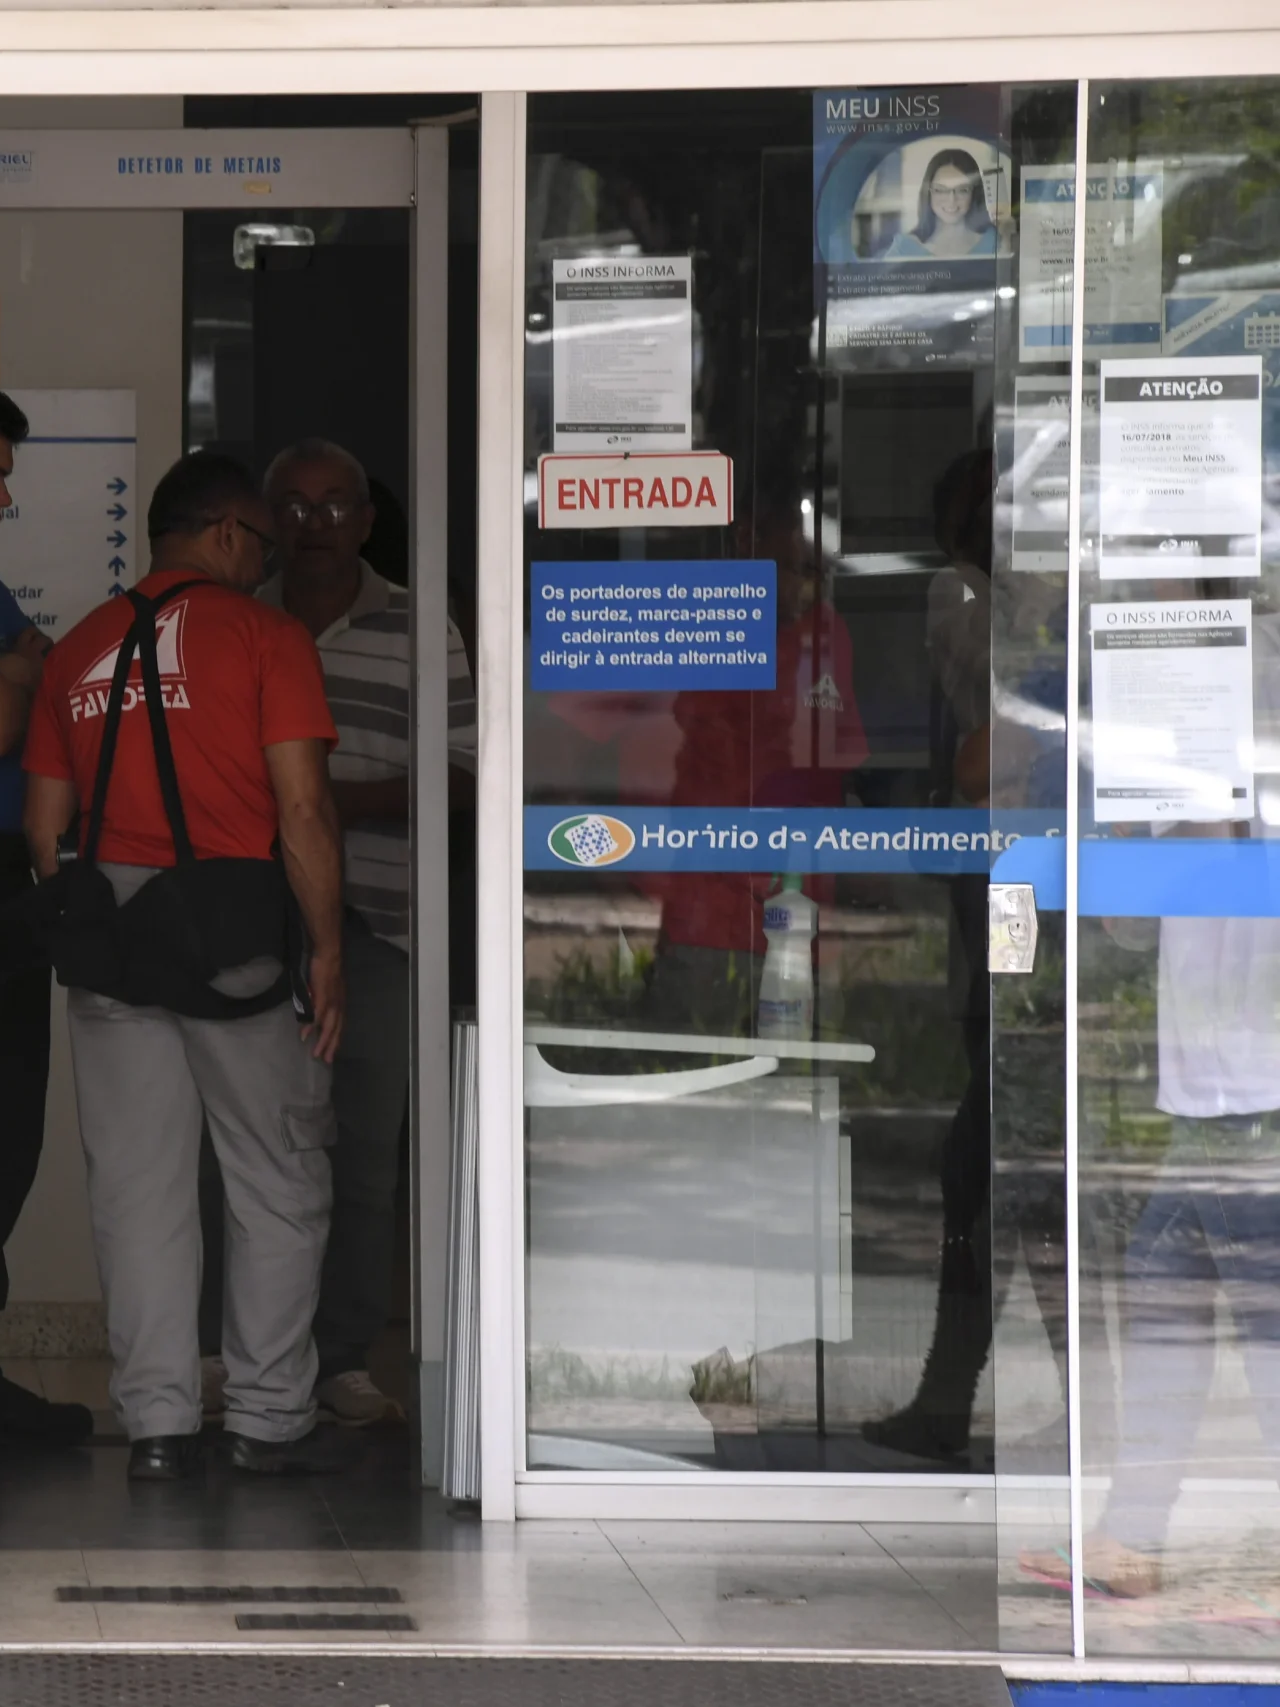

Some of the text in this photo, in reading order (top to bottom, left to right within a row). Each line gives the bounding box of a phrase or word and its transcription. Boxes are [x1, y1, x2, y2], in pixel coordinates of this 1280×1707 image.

[826, 95, 940, 119] MEU INSS
[826, 119, 940, 134] www.inss.gov.br
[118, 157, 282, 174] DETETOR DE METAIS
[567, 265, 676, 278] O INSS INFORMA
[1139, 378, 1224, 399] ATENÇÃO
[1182, 454, 1203, 463] Meu
[557, 476, 717, 510] ENTRADA
[541, 584, 767, 602] Os portadores de aparelho
[545, 607, 762, 624] de surdez, marca-passo e
[1106, 609, 1233, 624] O INSS INFORMA
[561, 629, 746, 644] cadeirantes devem se
[540, 650, 767, 669] dirigir à entrada alternativa
